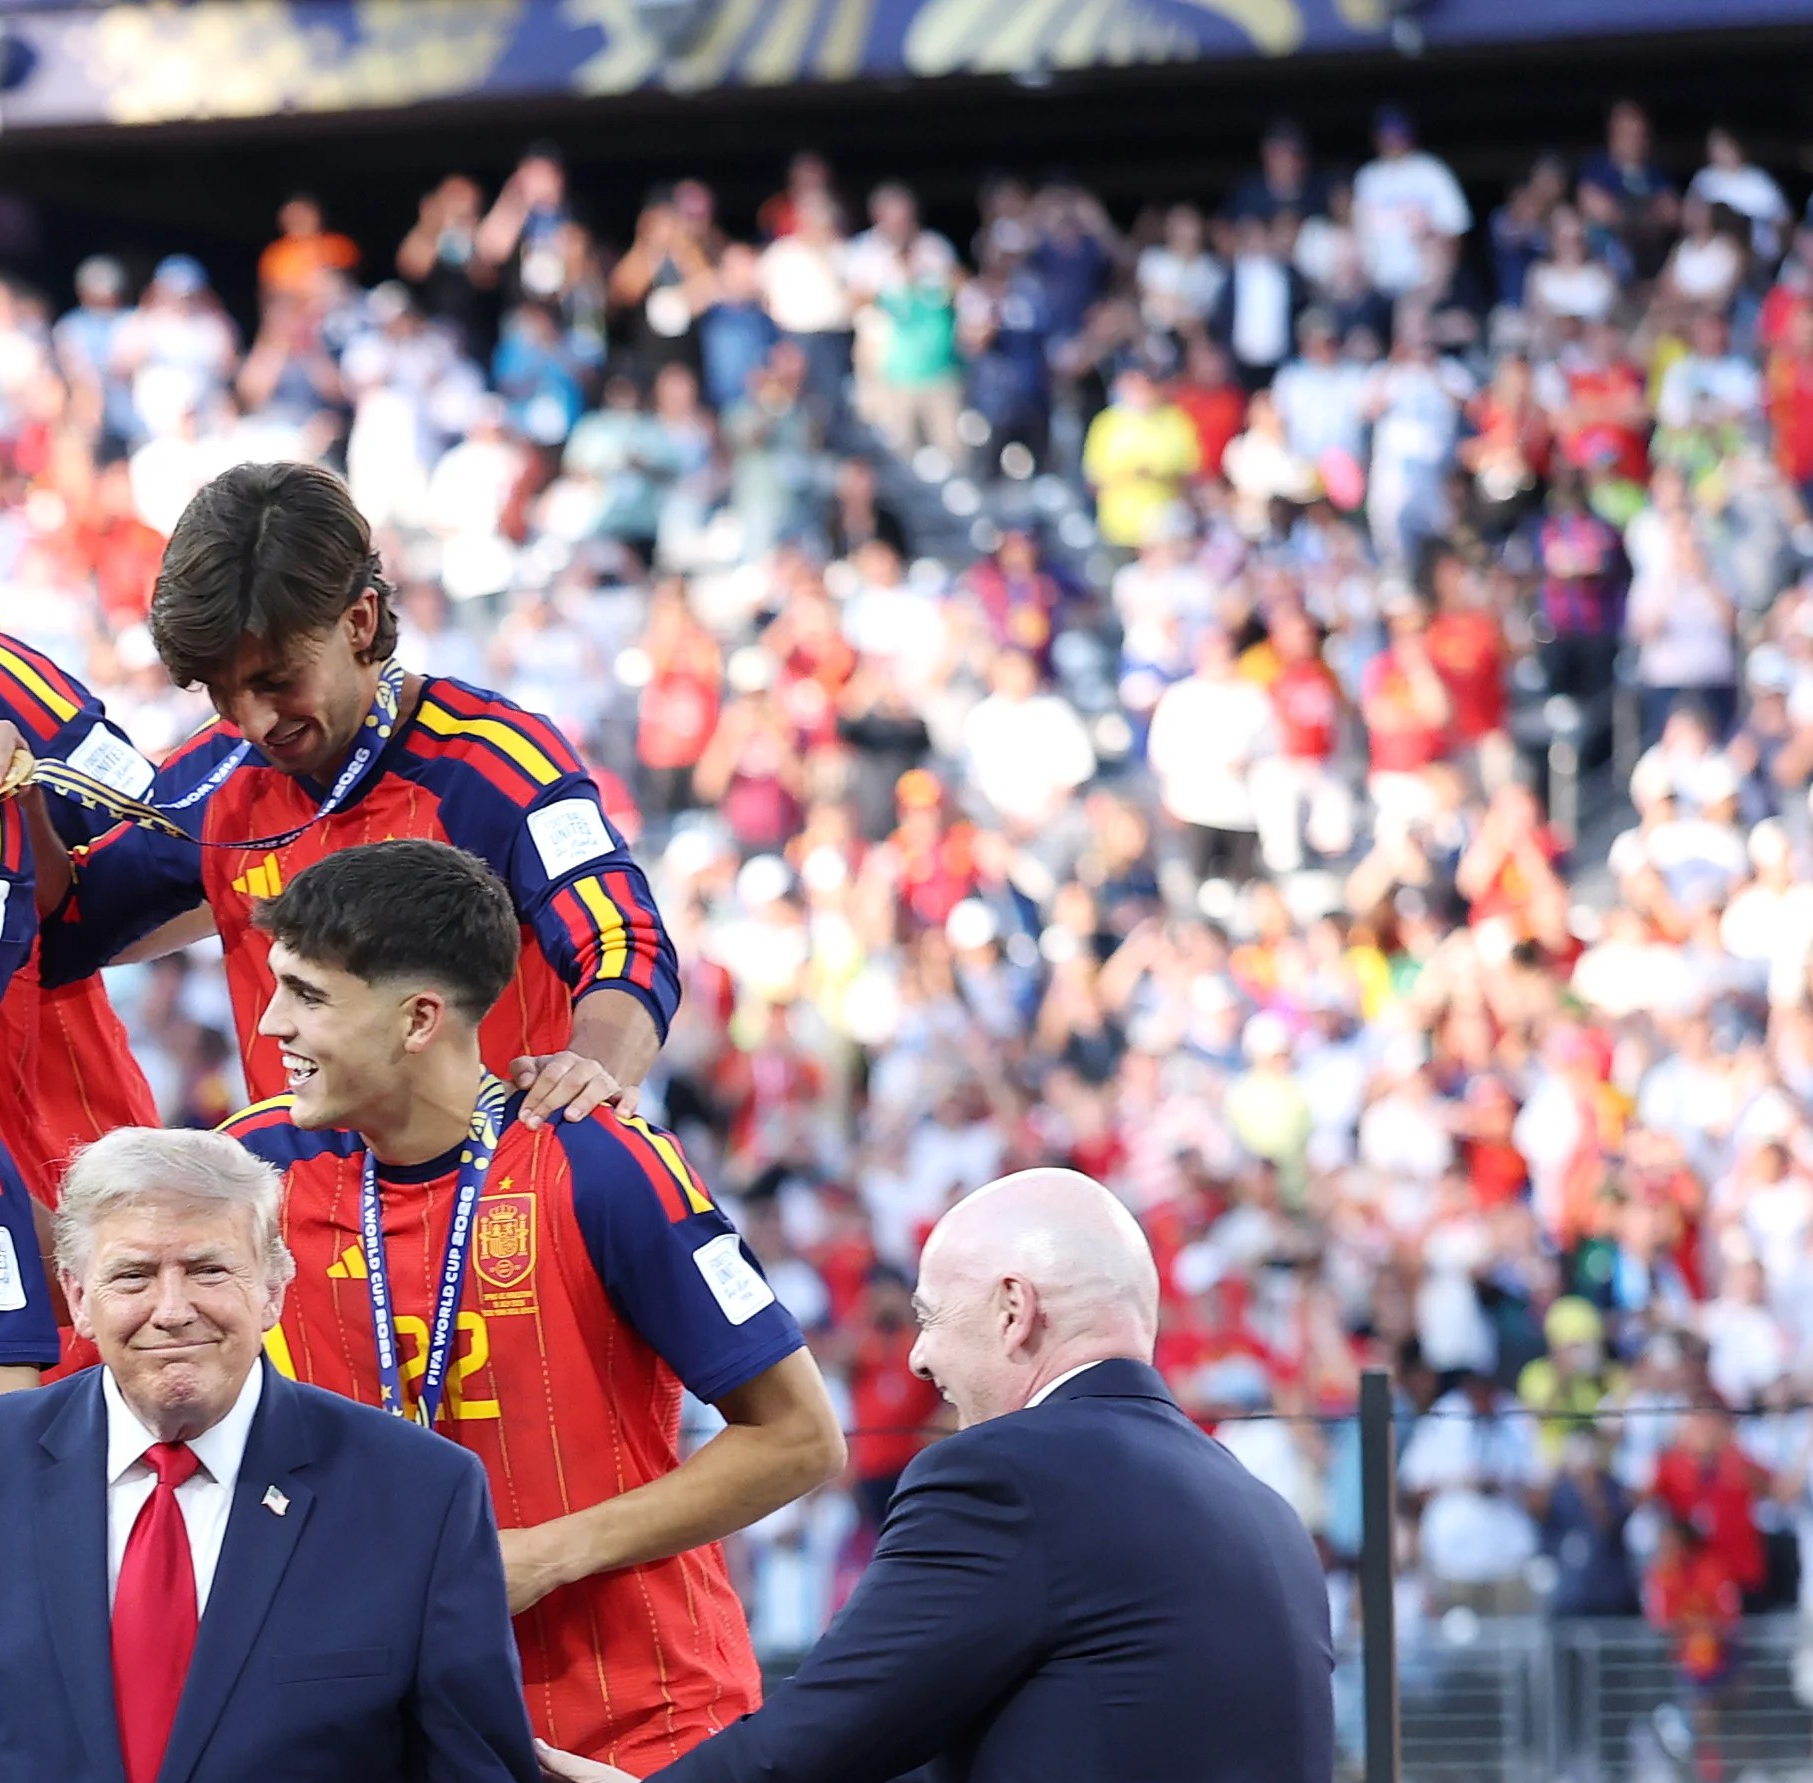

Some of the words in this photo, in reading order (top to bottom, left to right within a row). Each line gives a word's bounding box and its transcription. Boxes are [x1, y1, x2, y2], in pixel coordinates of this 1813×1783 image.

[331, 748, 371, 799] 2026
[364, 1170, 375, 1208] FIFA
[364, 1210, 381, 1269] WORLD
[451, 1185, 475, 1247] 2026
[371, 1270, 386, 1307] CUP
[444, 1247, 462, 1285] CUP
[375, 1307, 393, 1370] 2026
[433, 1284, 456, 1349] WORLD
[426, 1349, 443, 1387] FIFA
